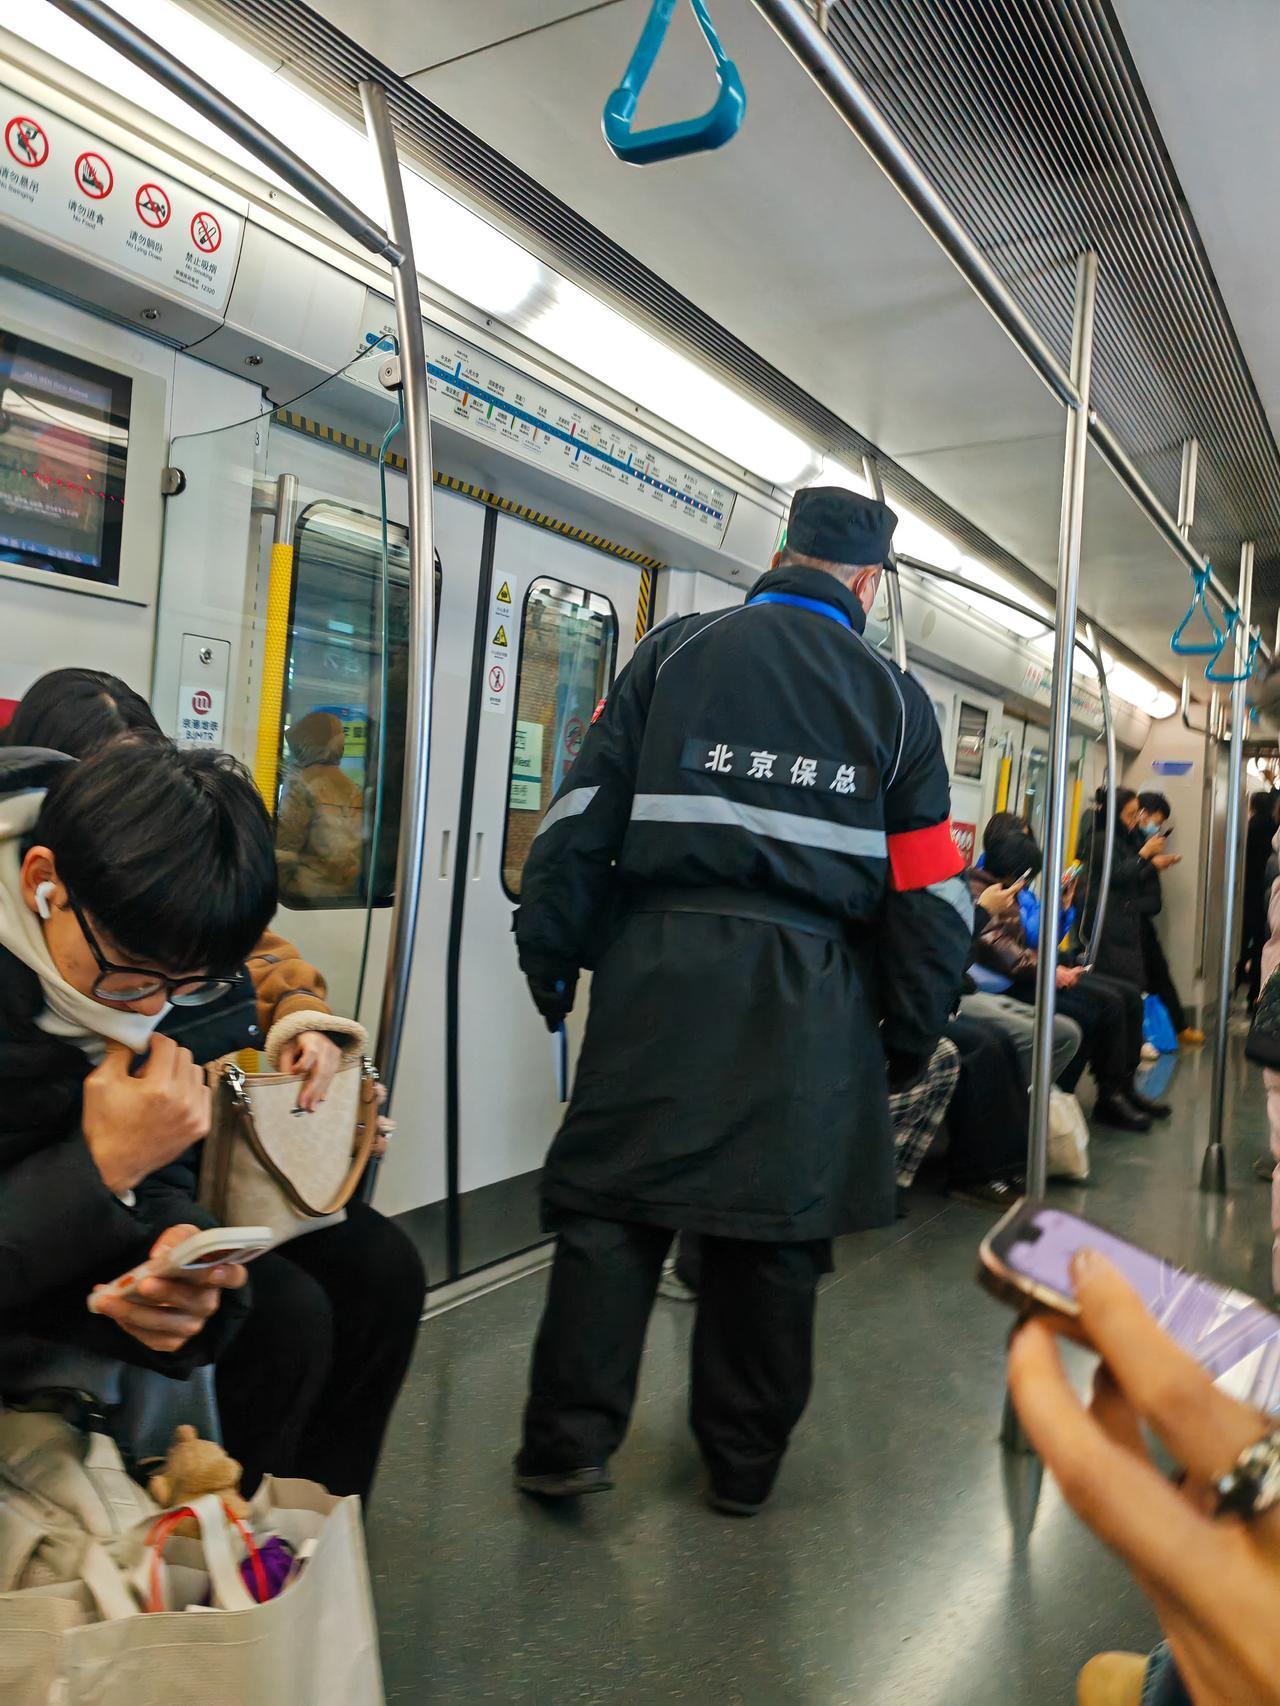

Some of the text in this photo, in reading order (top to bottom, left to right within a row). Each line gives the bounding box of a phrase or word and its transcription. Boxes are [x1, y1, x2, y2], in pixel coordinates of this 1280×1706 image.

[68, 200, 104, 226] 请勿进食
[82, 218, 96, 231] Food
[185, 252, 217, 275] 禁止吸烟
[704, 743, 857, 795] 北京保总
